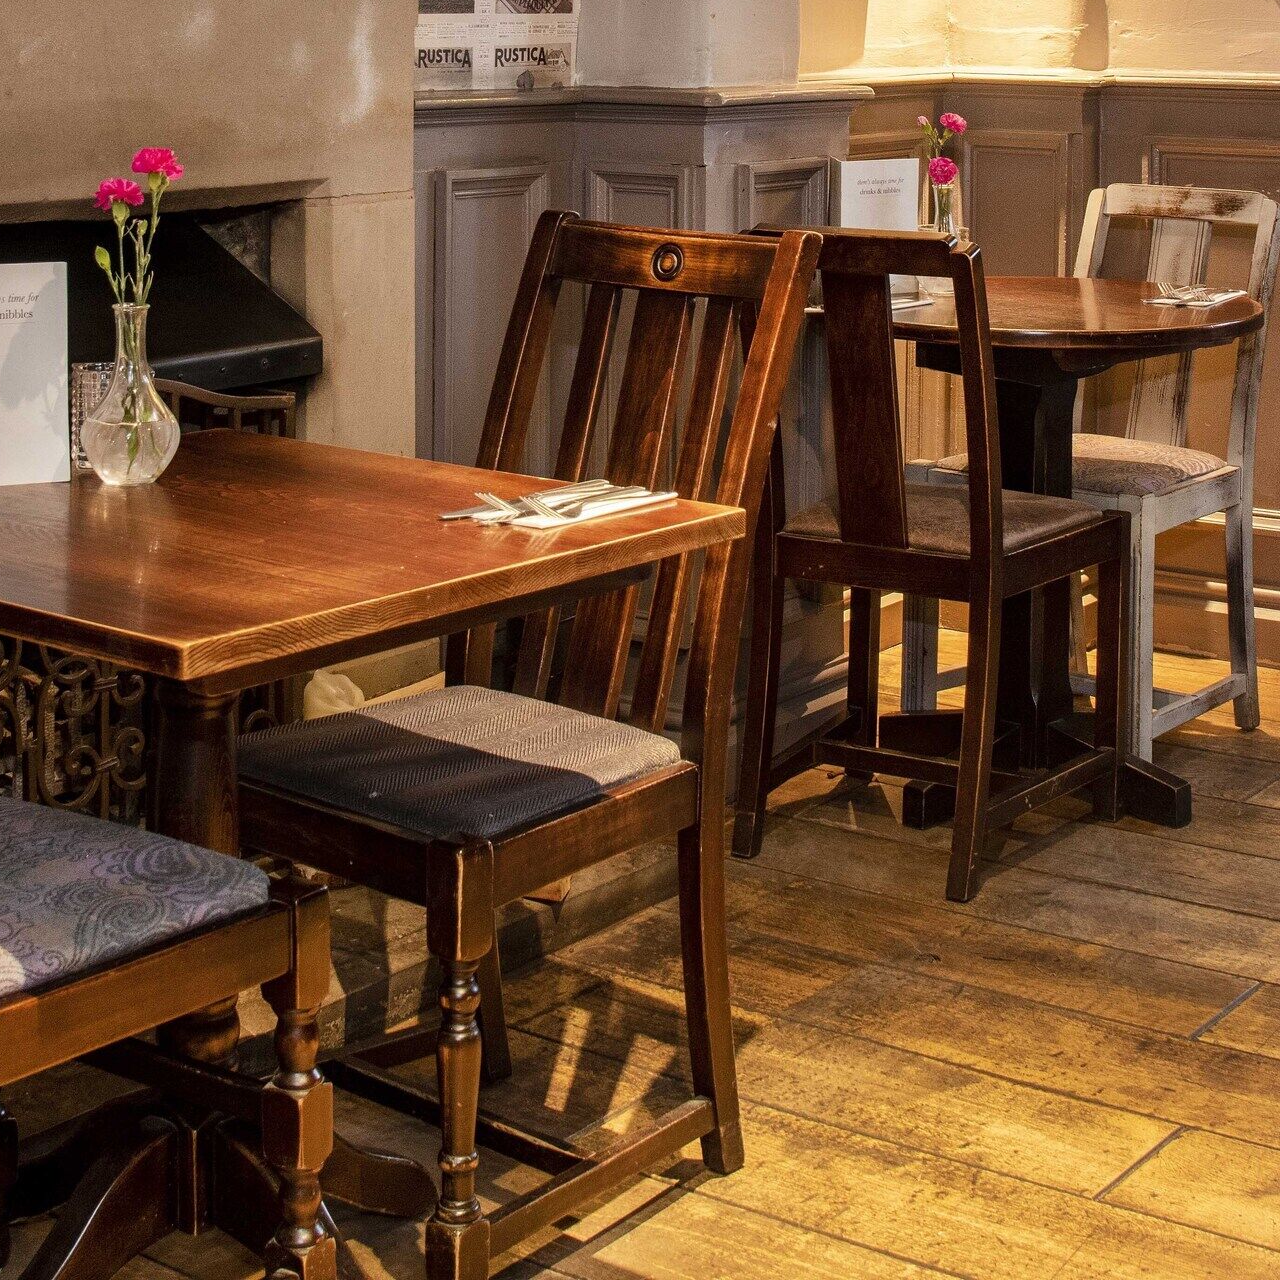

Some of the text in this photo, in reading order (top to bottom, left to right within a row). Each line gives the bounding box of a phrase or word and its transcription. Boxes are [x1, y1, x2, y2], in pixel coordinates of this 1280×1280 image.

[418, 49, 471, 68] RUSTICA
[494, 48, 546, 67] RUSTICA
[8, 293, 25, 303] time
[25, 292, 40, 304] for
[0, 309, 33, 319] nibbles
